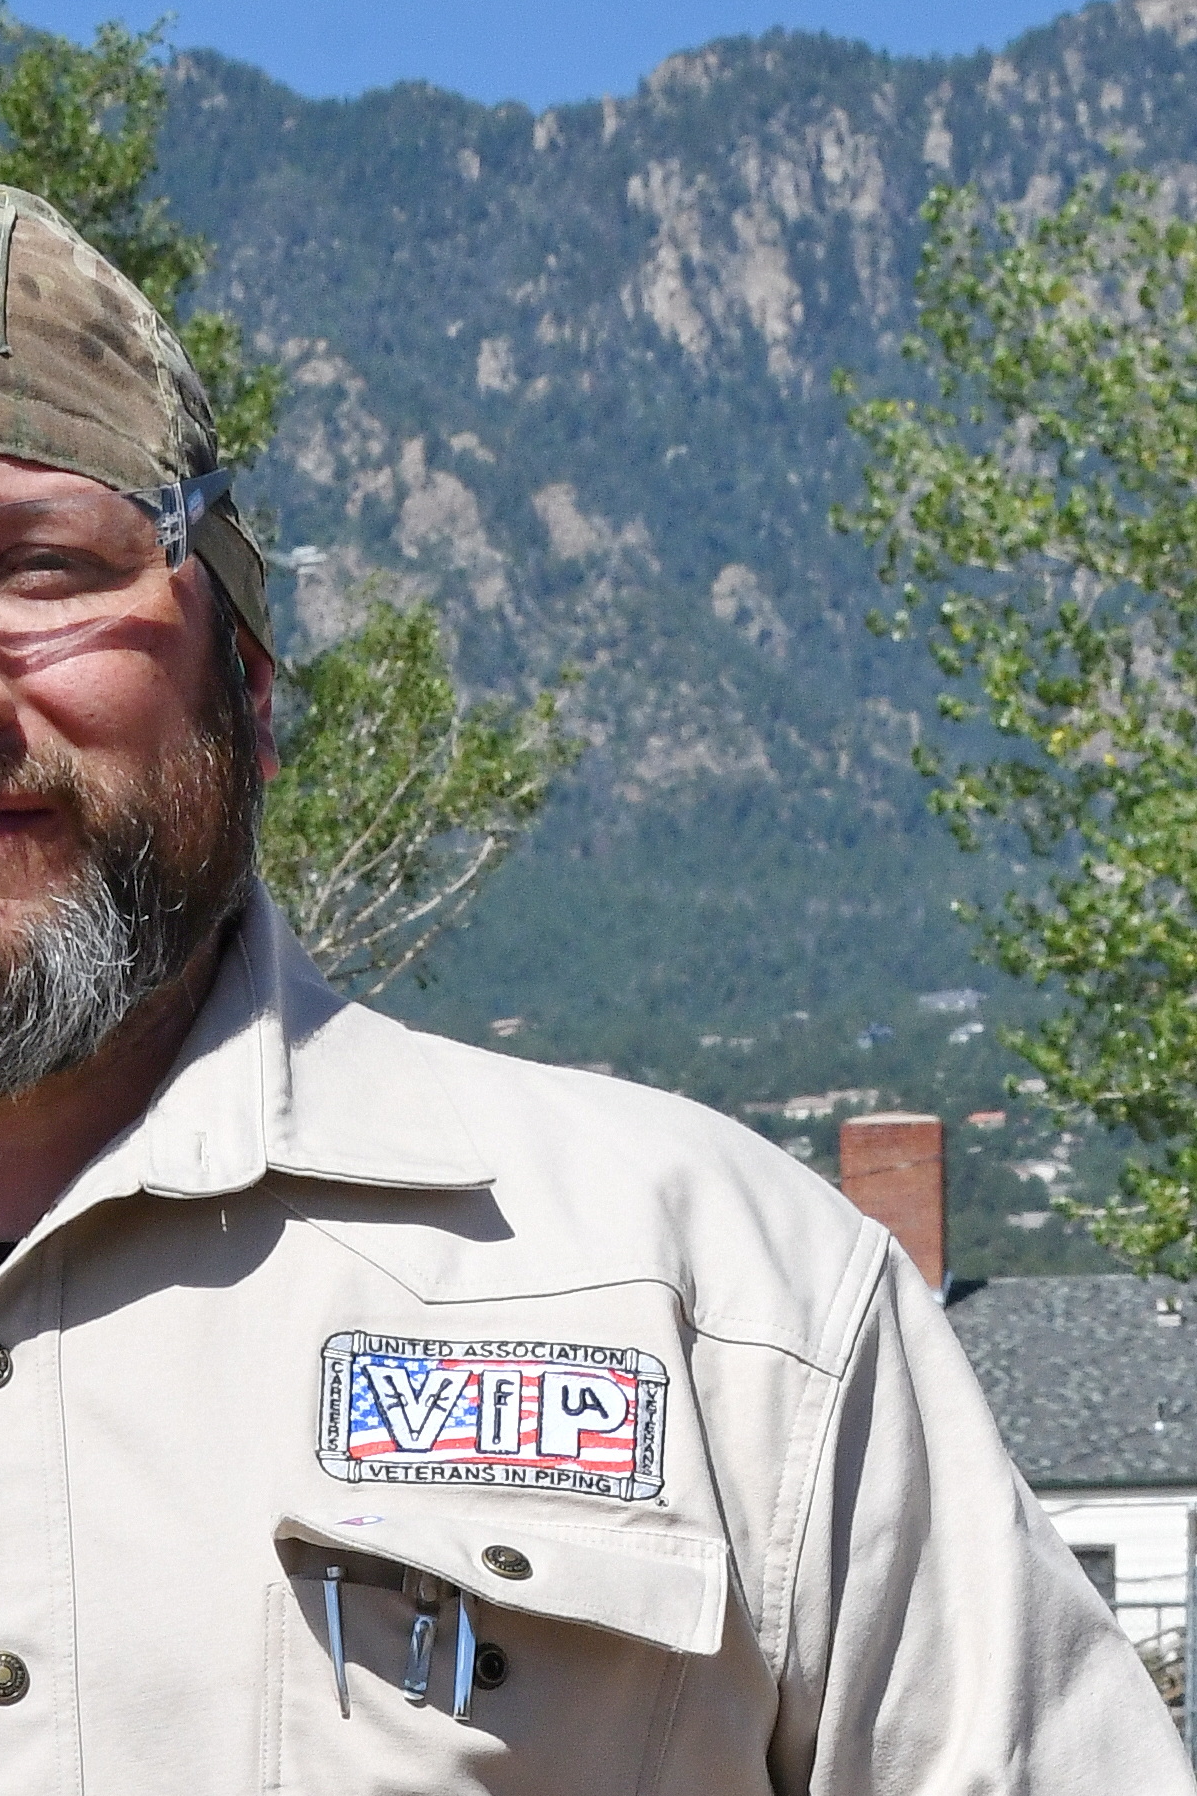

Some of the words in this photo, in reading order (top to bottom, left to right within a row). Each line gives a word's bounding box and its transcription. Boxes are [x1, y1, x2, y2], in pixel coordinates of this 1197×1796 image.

[367, 1336, 454, 1358] UNITED
[463, 1343, 625, 1366] ASSOCIATION
[327, 1360, 345, 1452] CAREERS
[363, 1364, 631, 1459] VIP
[642, 1381, 658, 1477] VETERANS
[368, 1463, 495, 1482] VETERANS
[504, 1467, 527, 1484] IN
[534, 1470, 613, 1494] PIPING
